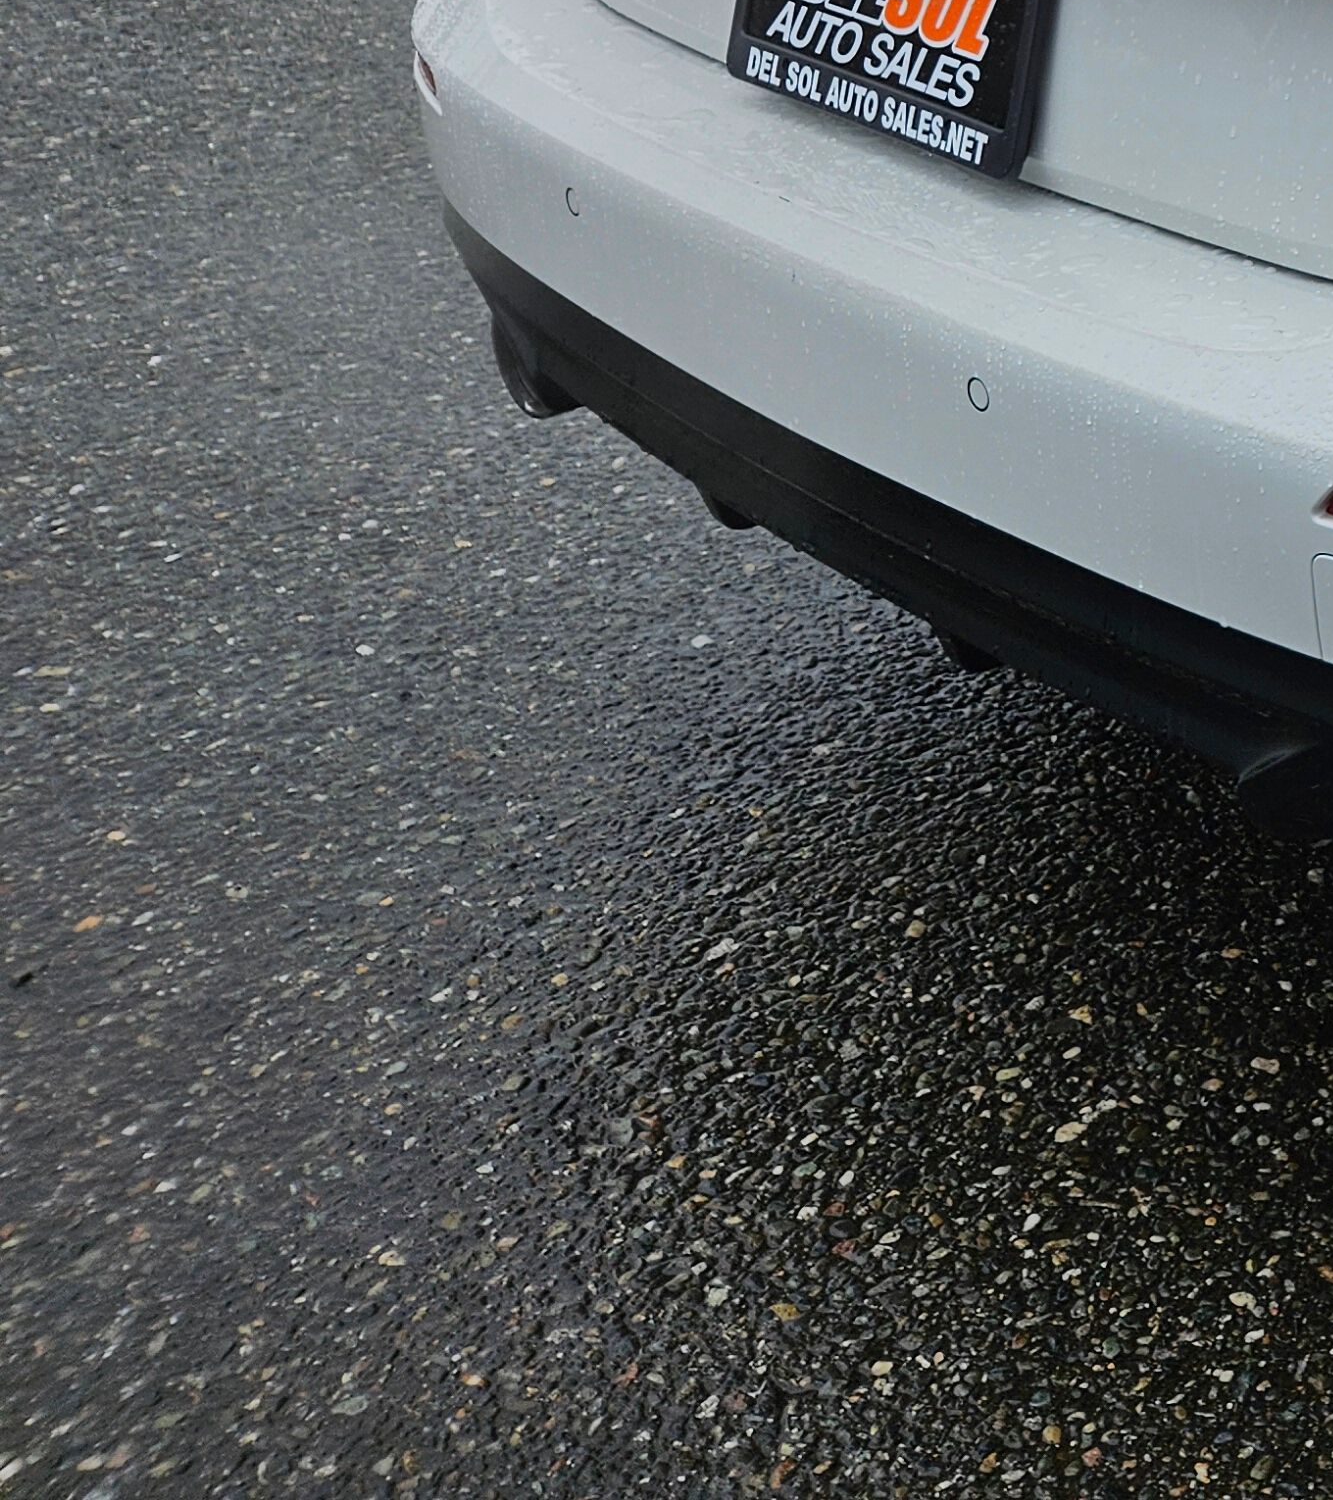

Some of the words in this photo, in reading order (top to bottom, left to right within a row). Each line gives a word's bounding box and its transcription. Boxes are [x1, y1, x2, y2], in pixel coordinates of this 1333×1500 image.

[746, 46, 781, 87] DEL
[785, 61, 822, 102] SOL
[825, 76, 878, 122] AUTO
[881, 96, 989, 165] SALES.NET
[766, 1, 863, 64] AUTO
[863, 33, 981, 107] SALES
